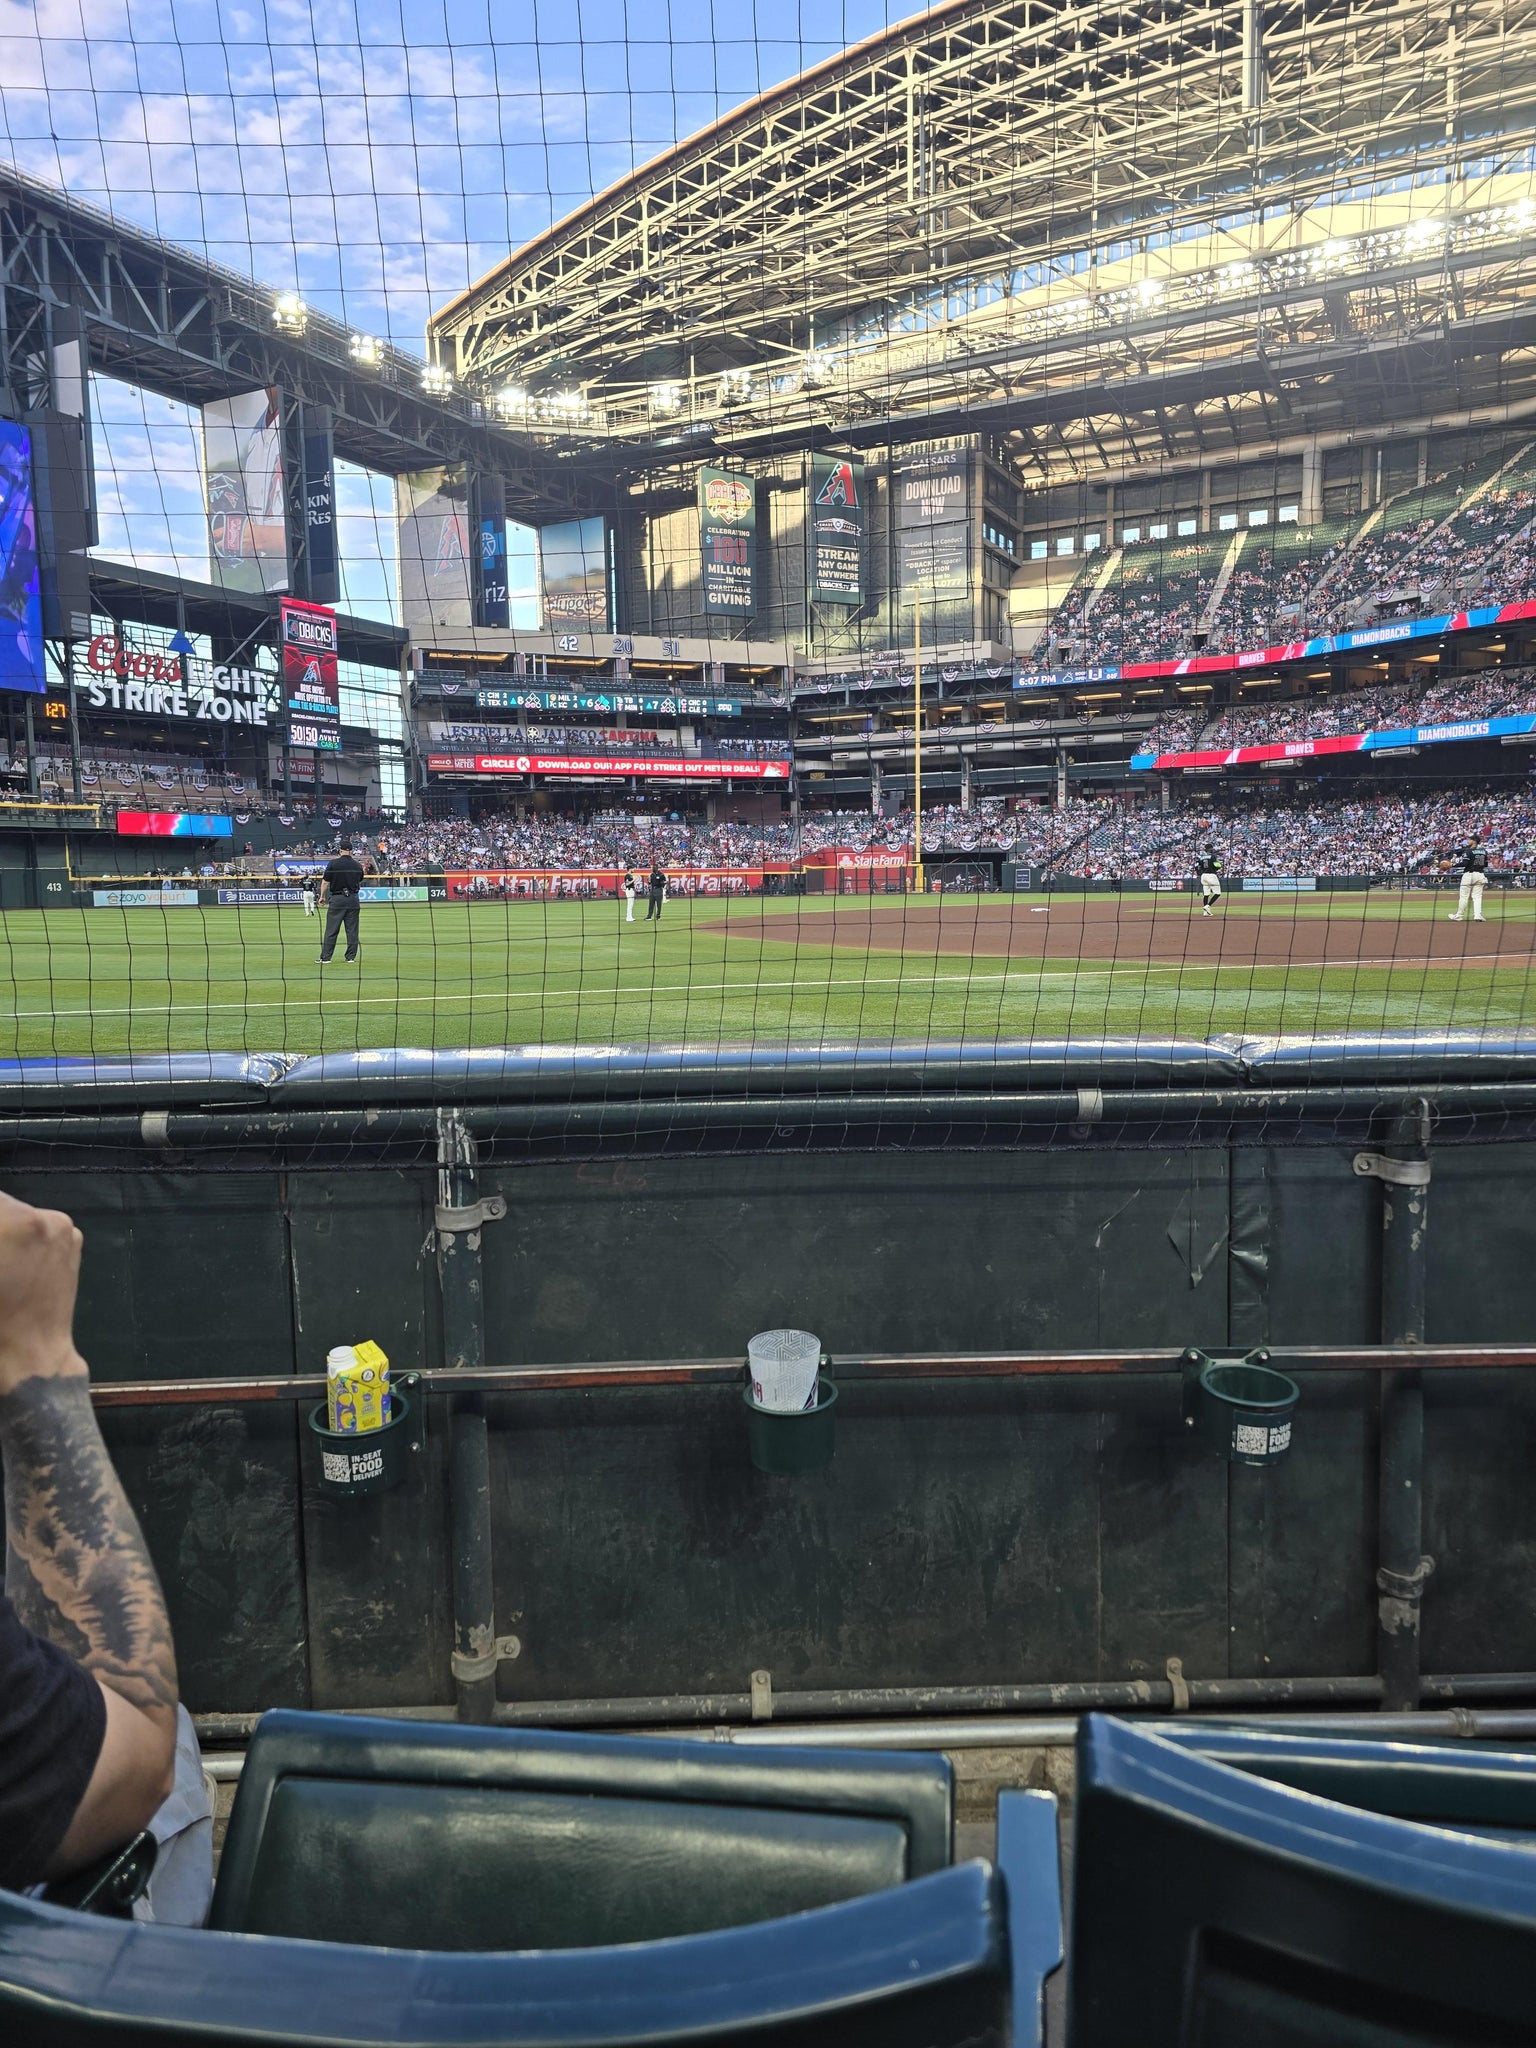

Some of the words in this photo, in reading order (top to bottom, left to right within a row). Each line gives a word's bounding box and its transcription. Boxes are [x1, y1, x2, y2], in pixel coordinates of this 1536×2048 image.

[906, 476, 960, 500] DOWNLOAD
[922, 496, 944, 516] NOW
[708, 527, 750, 537] CELEBRATING
[817, 548, 859, 562] STREAM
[708, 564, 751, 576] MILLION
[817, 560, 835, 569] ANY
[837, 563, 859, 571] GAME
[917, 566, 950, 574] LOCATION
[726, 576, 734, 584] IN
[818, 570, 859, 580] ANYWHERE
[485, 582, 506, 603] riz
[708, 584, 751, 593] CHARITABLE
[708, 592, 752, 606] GIVING
[299, 622, 332, 643] DBACKS
[1352, 625, 1411, 646] DIAMONDBACKS
[559, 635, 578, 651] 42
[612, 638, 634, 654] 20
[663, 641, 680, 656] 51
[88, 634, 183, 682] Coors
[1239, 652, 1265, 666] BRAVES
[187, 659, 266, 696] LIGHT
[1019, 676, 1039, 686] 6:07
[1041, 675, 1056, 684] PM
[88, 678, 188, 716] STRIKE
[196, 696, 268, 726] ZONE
[587, 699, 593, 707] 6
[653, 701, 659, 709] 7
[46, 702, 66, 718] 1:27
[451, 726, 523, 738] ESTRELLA
[542, 728, 596, 740] JALISCO
[599, 730, 657, 742] CANTINA
[1418, 723, 1489, 741] DIAMONDBACKS
[1285, 743, 1314, 756] BRAVES
[481, 759, 514, 768] CIRCLE
[538, 761, 591, 769] DOWNLOAD
[47, 883, 62, 891] 413
[239, 892, 276, 901] Banner
[278, 892, 304, 900] Healt
[387, 890, 417, 899] COX
[1270, 1430, 1291, 1446] FOOD
[351, 1449, 382, 1463] IN-SEAT
[352, 1458, 383, 1475] FOOD
[353, 1469, 384, 1481] DELIVERY
